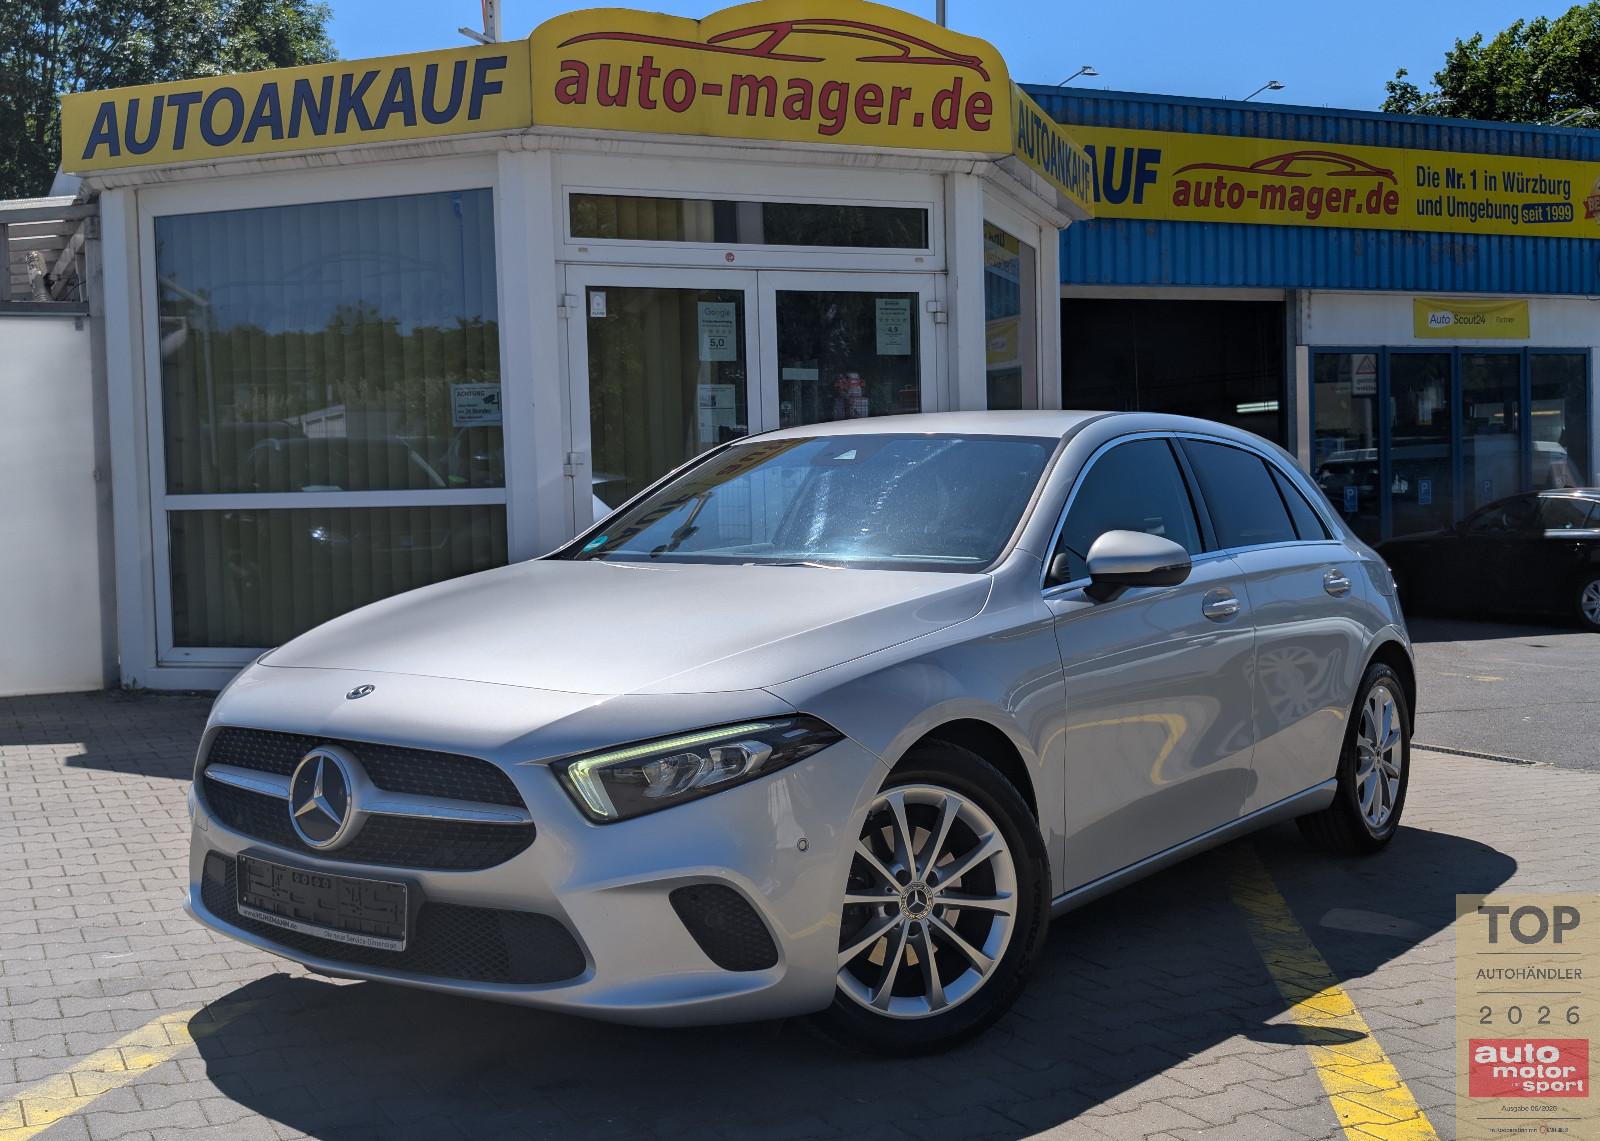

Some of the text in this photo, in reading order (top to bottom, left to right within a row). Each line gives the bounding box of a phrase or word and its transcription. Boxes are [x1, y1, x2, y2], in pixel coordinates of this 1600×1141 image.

[81, 56, 508, 160] AUTOANKAUF
[554, 56, 993, 136] auto-mager.de
[1017, 99, 1090, 204] AUTOANKAUF
[1172, 175, 1399, 220] auto-mager.de
[1416, 165, 1571, 200] Die Nr. 1 in Würzburg
[1416, 195, 1572, 225] und Umgebung seit 1999
[1429, 313, 1451, 324] Auto
[1453, 313, 1486, 325] Scout24
[709, 338, 725, 348] 5,0
